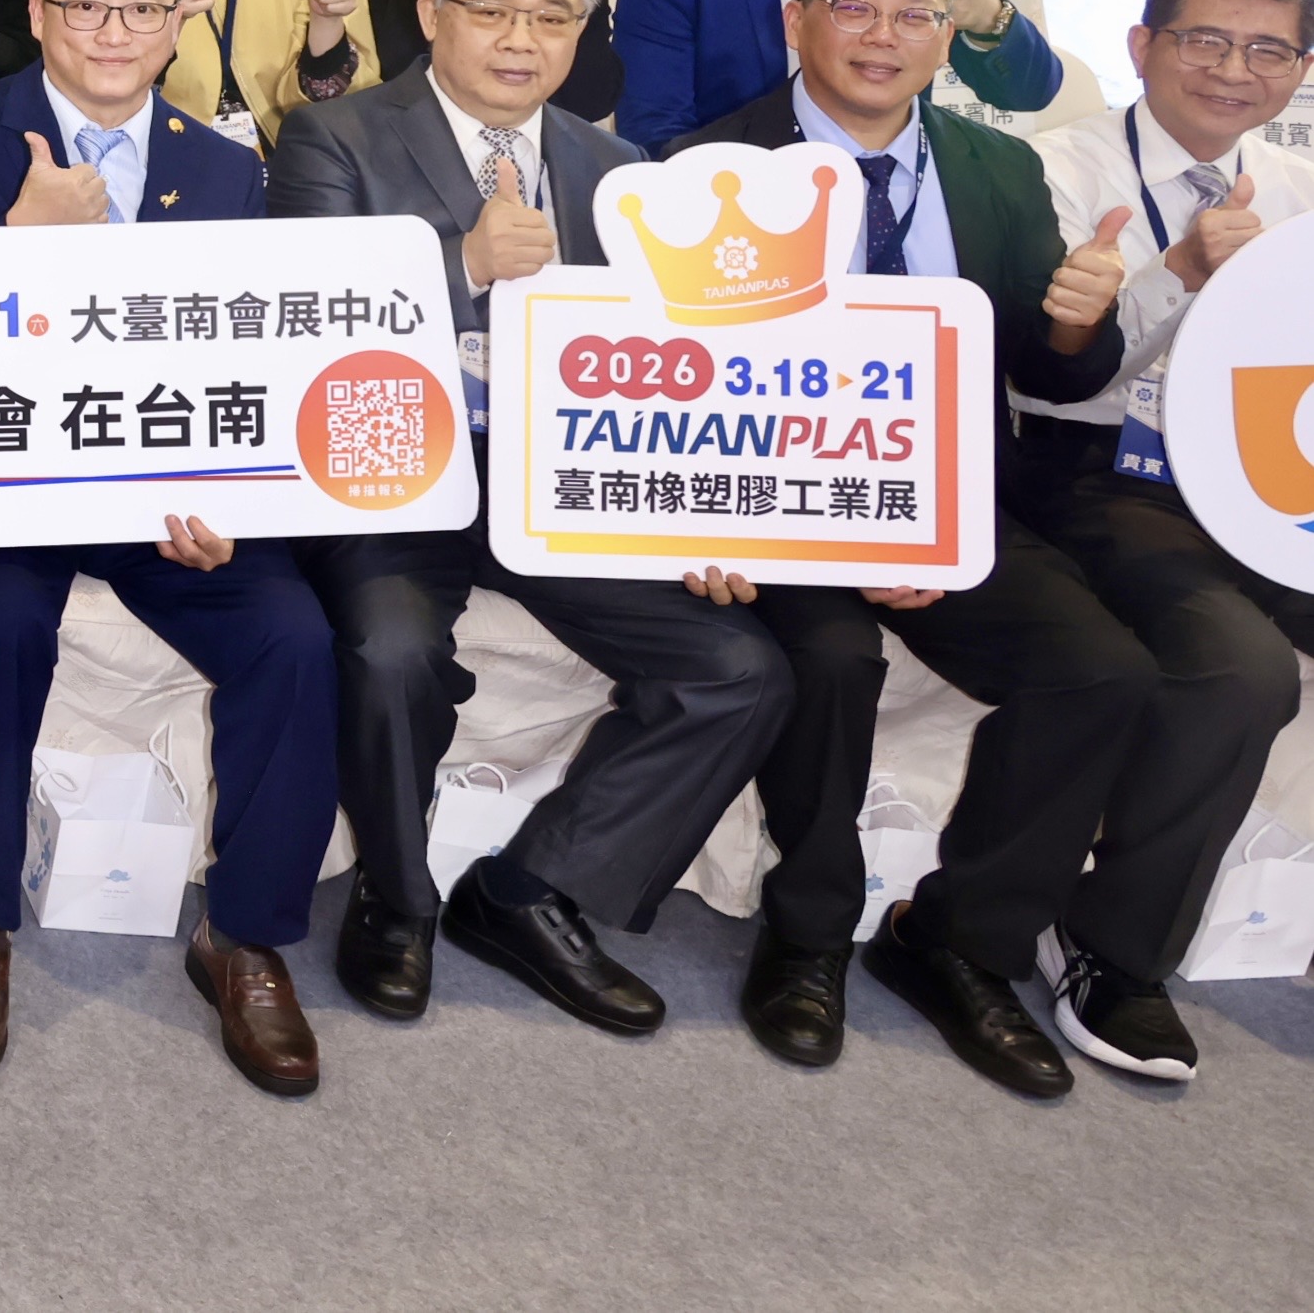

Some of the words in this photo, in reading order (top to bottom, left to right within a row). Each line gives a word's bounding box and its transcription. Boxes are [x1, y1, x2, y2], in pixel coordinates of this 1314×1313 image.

[1262, 121, 1312, 148] 貴賓
[30, 318, 47, 333] 六
[69, 287, 426, 344] 大臺南會展中心
[576, 350, 698, 386] 2026
[724, 355, 829, 399] 3.18
[860, 360, 915, 401] 21
[59, 380, 269, 451] 在台南
[347, 482, 407, 498] 掃描報名
[1120, 451, 1164, 478] 貴賓
[553, 467, 919, 523] 臺南橡塑膠工業展
